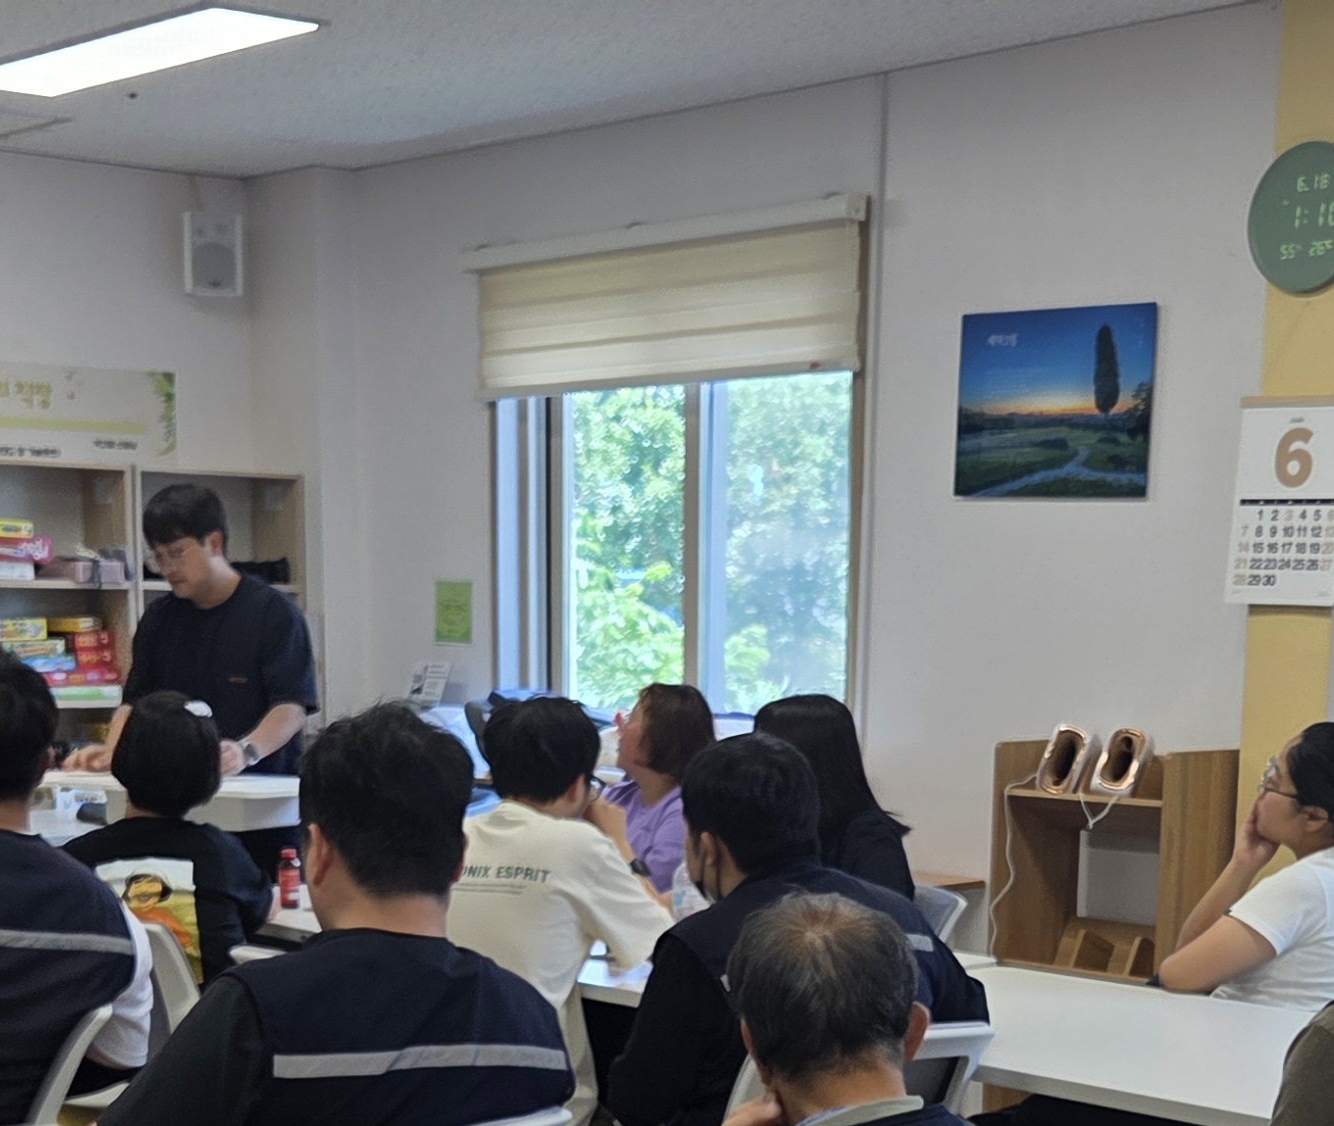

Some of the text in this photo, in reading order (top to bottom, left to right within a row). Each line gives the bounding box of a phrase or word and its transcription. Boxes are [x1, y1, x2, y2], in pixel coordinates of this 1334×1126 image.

[1275, 427, 1314, 489] 6
[1257, 509, 1264, 521] 1
[1270, 509, 1279, 521] 2
[1299, 509, 1307, 521] 4
[1313, 509, 1322, 521] 5
[1254, 526, 1263, 538] 8
[1269, 526, 1278, 538] 9
[1282, 526, 1295, 538] 10
[1296, 526, 1308, 538] 11
[1310, 526, 1323, 538] 12
[1252, 543, 1264, 554] 15
[1267, 543, 1279, 554] 16
[1281, 543, 1293, 554] 17
[1295, 543, 1307, 554] 18
[1309, 543, 1321, 554] 19
[1249, 558, 1263, 571] 22
[1263, 558, 1277, 571] 23
[1277, 558, 1291, 571] 24
[1291, 558, 1305, 571] 25
[1305, 558, 1319, 571] 26
[1247, 574, 1261, 586] 29
[1262, 574, 1276, 586] 30
[495, 866, 552, 883] ESPRIT
